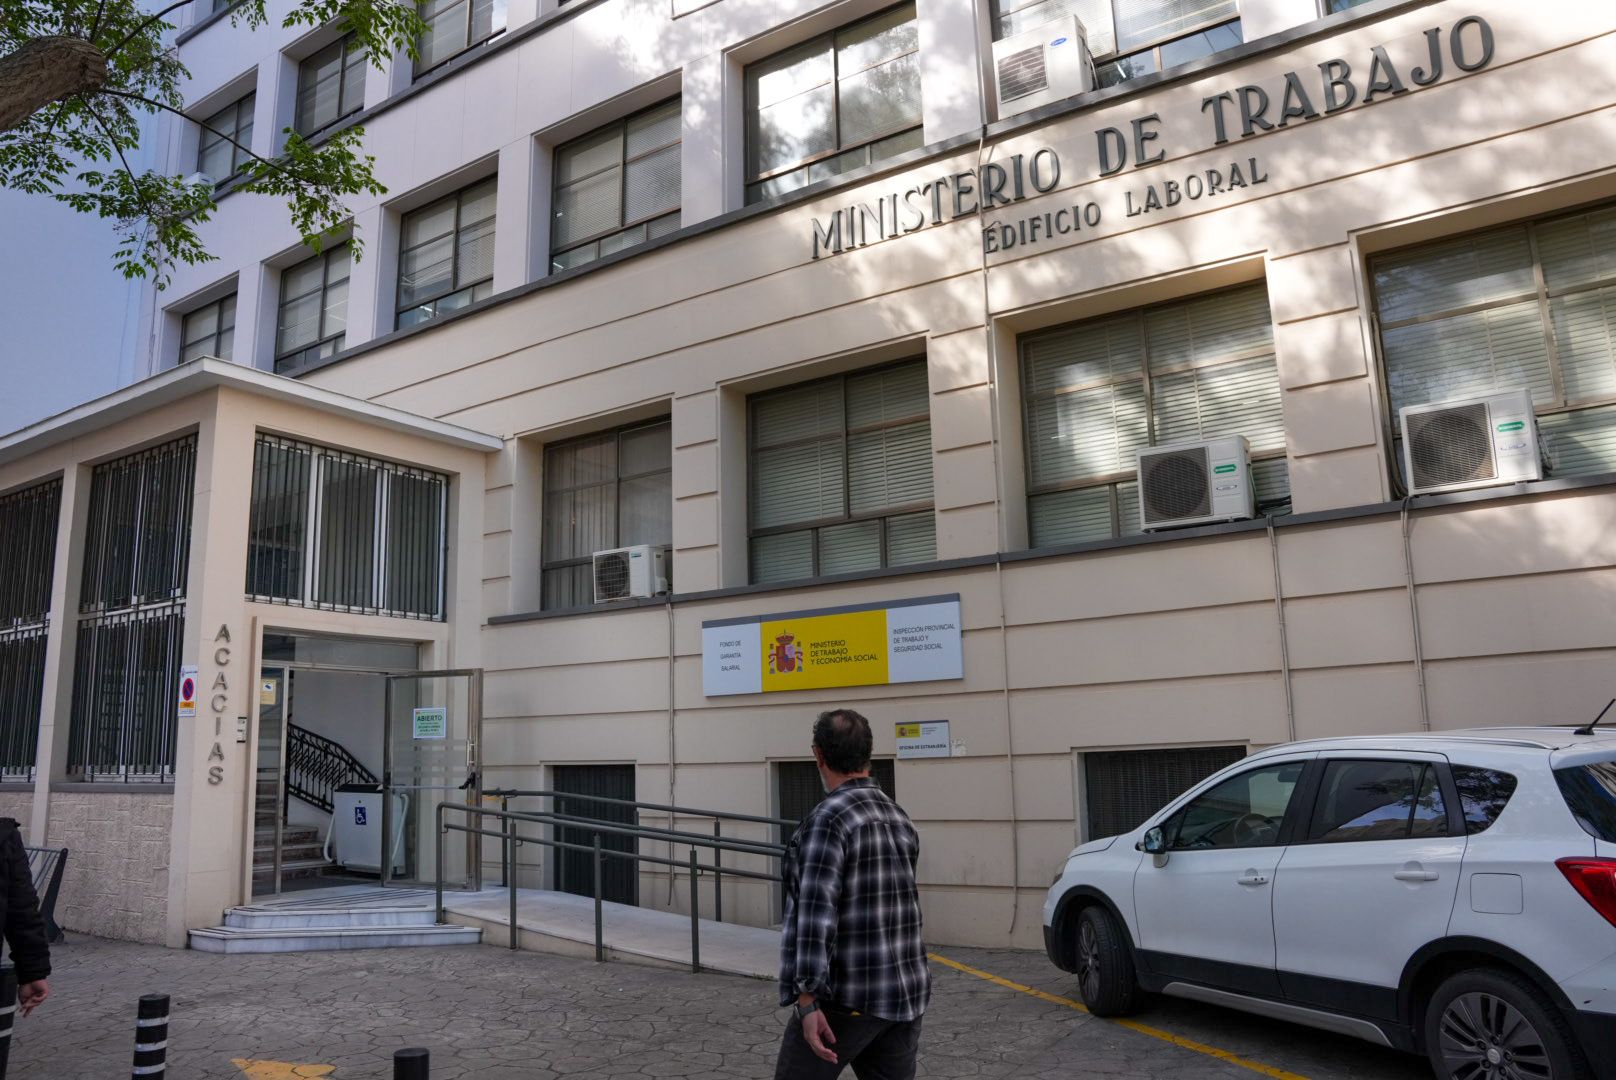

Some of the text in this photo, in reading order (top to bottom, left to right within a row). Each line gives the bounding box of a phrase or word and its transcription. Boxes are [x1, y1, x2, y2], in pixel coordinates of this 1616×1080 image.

[810, 15, 1495, 259] MINISTERIO DE TRABAJO
[983, 157, 1268, 254] EDIFICIO LABORAL
[901, 635, 925, 643] TRABAJO
[810, 640, 846, 649] MINISTERIO
[893, 642, 943, 652] SEGURIDAD SOCIAL
[810, 648, 848, 658] DE TRABAJO
[853, 653, 878, 662] SOCIAL
[207, 623, 232, 786] ACACIAS
[416, 714, 443, 722] ABIERTO
